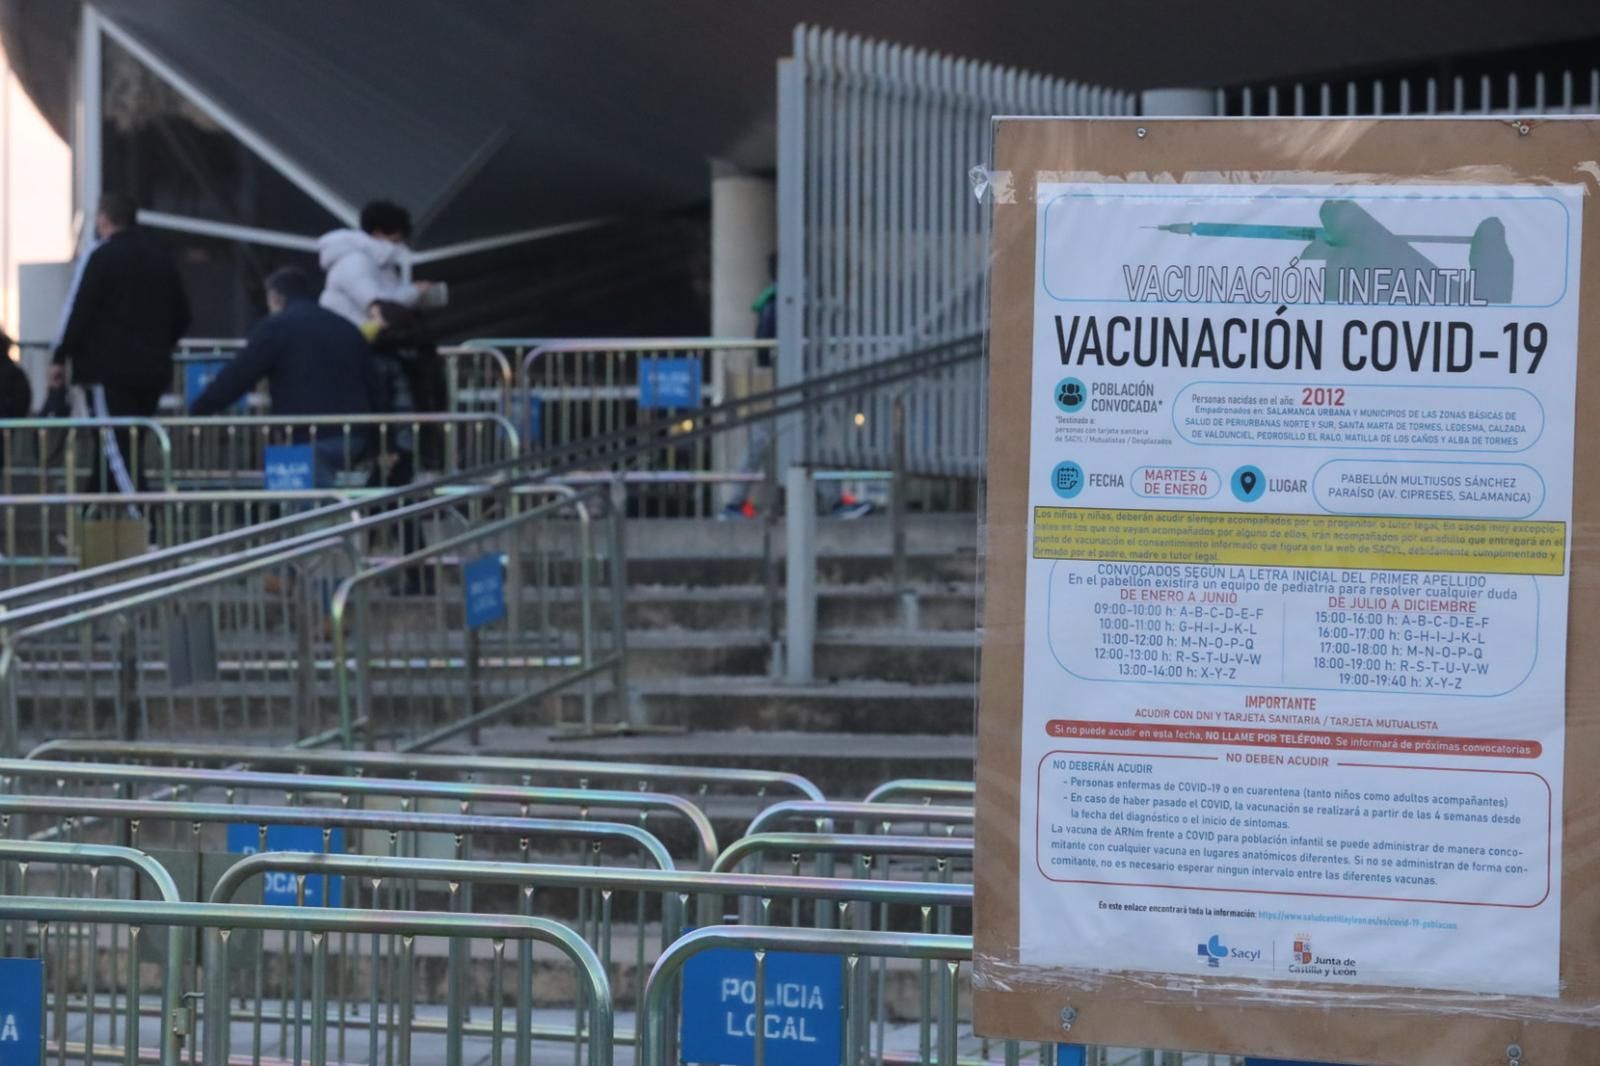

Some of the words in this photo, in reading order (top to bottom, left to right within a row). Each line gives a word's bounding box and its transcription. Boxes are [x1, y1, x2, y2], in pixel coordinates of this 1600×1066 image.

[1122, 257, 1325, 304] VACUNACIÓN
[1338, 266, 1488, 306] INFANTIL
[1054, 305, 1322, 370] VACUNACIÓN
[1342, 319, 1547, 374] COVID-19
[1091, 380, 1154, 396] POBLACIÓN
[1191, 393, 1226, 404] Personas
[1227, 395, 1257, 404] nacidas
[1301, 387, 1345, 406] 2012
[1194, 405, 1251, 414] Empadronados
[1266, 407, 1315, 415] SALAMANCA
[1317, 408, 1350, 416] URBANA
[1359, 408, 1406, 417] MUNICIPIOS
[1408, 409, 1419, 418] DE
[1421, 410, 1437, 418] LAS
[1439, 410, 1466, 419] ZONAS
[1468, 410, 1503, 420] BÁSICAS
[1504, 411, 1516, 420] DE
[1089, 473, 1124, 488] FECHA
[1144, 468, 1196, 481] MARTES
[1200, 470, 1207, 481] 4
[1340, 473, 1397, 484] PABELLÓN
[1400, 475, 1461, 486] MULTIUSOS
[1464, 476, 1516, 488] SÁNCHEZ
[1144, 482, 1160, 494] DE
[1164, 483, 1207, 495] ENERO
[1269, 479, 1307, 494] LUGAR
[1328, 487, 1374, 498] PARAÍSO
[1377, 488, 1397, 499] (AV.
[1400, 489, 1455, 500] CIPRESES,
[1458, 490, 1531, 502] SALAMANCA)
[1098, 564, 1180, 578] CONVOCADOS
[1184, 566, 1225, 579] SEGÚN
[1229, 567, 1245, 580] LA
[1249, 568, 1288, 580] LETRA
[1292, 570, 1337, 583] INICIAL
[1341, 571, 1366, 583] DEL
[1370, 572, 1418, 584] PRIMER
[1422, 574, 1486, 587] APELLIDO
[1068, 573, 1082, 584] En
[1086, 574, 1096, 585] el
[1100, 571, 1151, 587] pabellón
[1154, 578, 1199, 588] existirá
[1202, 580, 1217, 589] un
[1220, 581, 1260, 593] equipo
[1263, 580, 1278, 591] de
[1281, 578, 1334, 593] pediatría
[1338, 585, 1366, 596] para
[1369, 585, 1421, 596] resolver
[1425, 586, 1483, 599] cualquier
[1487, 587, 1517, 599] duda
[1120, 588, 1136, 600] DE
[1140, 589, 1184, 601] ENERO
[1187, 591, 1196, 601] A
[1201, 592, 1237, 603] JUNIO
[1094, 602, 1162, 616] 09:00-10:00
[1165, 605, 1176, 616] h:
[1179, 605, 1263, 619] A-B-C-D-E-F
[1328, 596, 1345, 608] DE
[1350, 597, 1386, 609] JULIO
[1390, 598, 1400, 609] A
[1403, 599, 1476, 612] DICIEMBRE
[1099, 617, 1161, 631] 10:00-11:00
[1164, 620, 1174, 631] h:
[1178, 621, 1256, 634] G-H-I-J-K-L
[1315, 611, 1382, 624] 15:00-16:00
[1386, 613, 1397, 625] h:
[1401, 614, 1488, 628] A-B-C-D-E-F
[1102, 632, 1163, 646] 11:00-12:00
[1166, 635, 1177, 646] h:
[1180, 636, 1254, 649] M-N-O-P-Q
[1318, 626, 1384, 640] 16:00-17:00
[1388, 629, 1400, 640] h:
[1403, 629, 1485, 643] G-H-I-J-K-L
[1094, 647, 1158, 661] 12:00-13:00
[1161, 650, 1171, 661] h:
[1175, 650, 1261, 664] R-S-T-U-V-W
[1320, 641, 1387, 655] 17:00-18:00
[1391, 644, 1402, 656] h:
[1406, 645, 1482, 659] M-N-O-P-Q
[1119, 663, 1182, 677] 13:00-14:00
[1186, 666, 1196, 677] h:
[1200, 666, 1236, 679] X-Y-Z
[1314, 656, 1381, 670] 18:00-19:00
[1384, 659, 1396, 671] h:
[1399, 660, 1488, 674] R-S-T-U-V-W
[1339, 672, 1406, 686] 19:00-19:40
[1410, 676, 1421, 687] h:
[1425, 676, 1462, 689] X-Y-Z
[1244, 695, 1316, 710] IMPORTANTE
[1134, 708, 1170, 718] ACUDIR
[1172, 709, 1194, 719] CON
[1195, 710, 1213, 720] DNI
[1215, 711, 1221, 720] Y
[1224, 712, 1266, 722] TARJETA
[1268, 714, 1320, 724] SANITARIA
[1330, 716, 1373, 727] TARJETA
[1375, 719, 1438, 729] MUTUALISTA
[1054, 724, 1064, 733] Si
[1066, 726, 1077, 734] no
[1079, 726, 1106, 736] puede
[1108, 727, 1136, 736] acudir
[1138, 729, 1150, 737] en
[1152, 729, 1172, 738] esta
[1204, 731, 1220, 740] NO
[1221, 731, 1255, 742] LLAME
[1257, 733, 1277, 742] POR
[1335, 736, 1348, 746] Se
[1350, 737, 1398, 748] informará
[1400, 740, 1412, 749] de
[1414, 740, 1460, 752] próximas
[1462, 743, 1531, 754] convocatorias
[1052, 759, 1066, 769] NO
[1068, 760, 1114, 771] DEBERÁN
[1116, 763, 1152, 773] ACUDIR
[1226, 752, 1242, 762] NO
[1244, 753, 1284, 764] DEBEN
[1287, 755, 1328, 766] ACUDIR
[1070, 776, 1114, 788] Personas
[1116, 779, 1161, 790] enfermas
[1163, 781, 1175, 791] de
[1178, 781, 1220, 793] COVID-19
[1223, 786, 1229, 794] o
[1232, 786, 1244, 794] en
[1246, 787, 1300, 796] cuarentena
[1303, 788, 1331, 799] (tanto
[1334, 788, 1360, 800] niños
[1363, 792, 1390, 801] como
[1392, 792, 1429, 803] adultos
[1431, 794, 1508, 807] acompañantes)
[1231, 948, 1261, 961] Sacyl
[1314, 956, 1341, 966] Junta
[1345, 958, 1356, 967] de
[1288, 964, 1322, 975] Castilla
[1333, 966, 1357, 977] León
